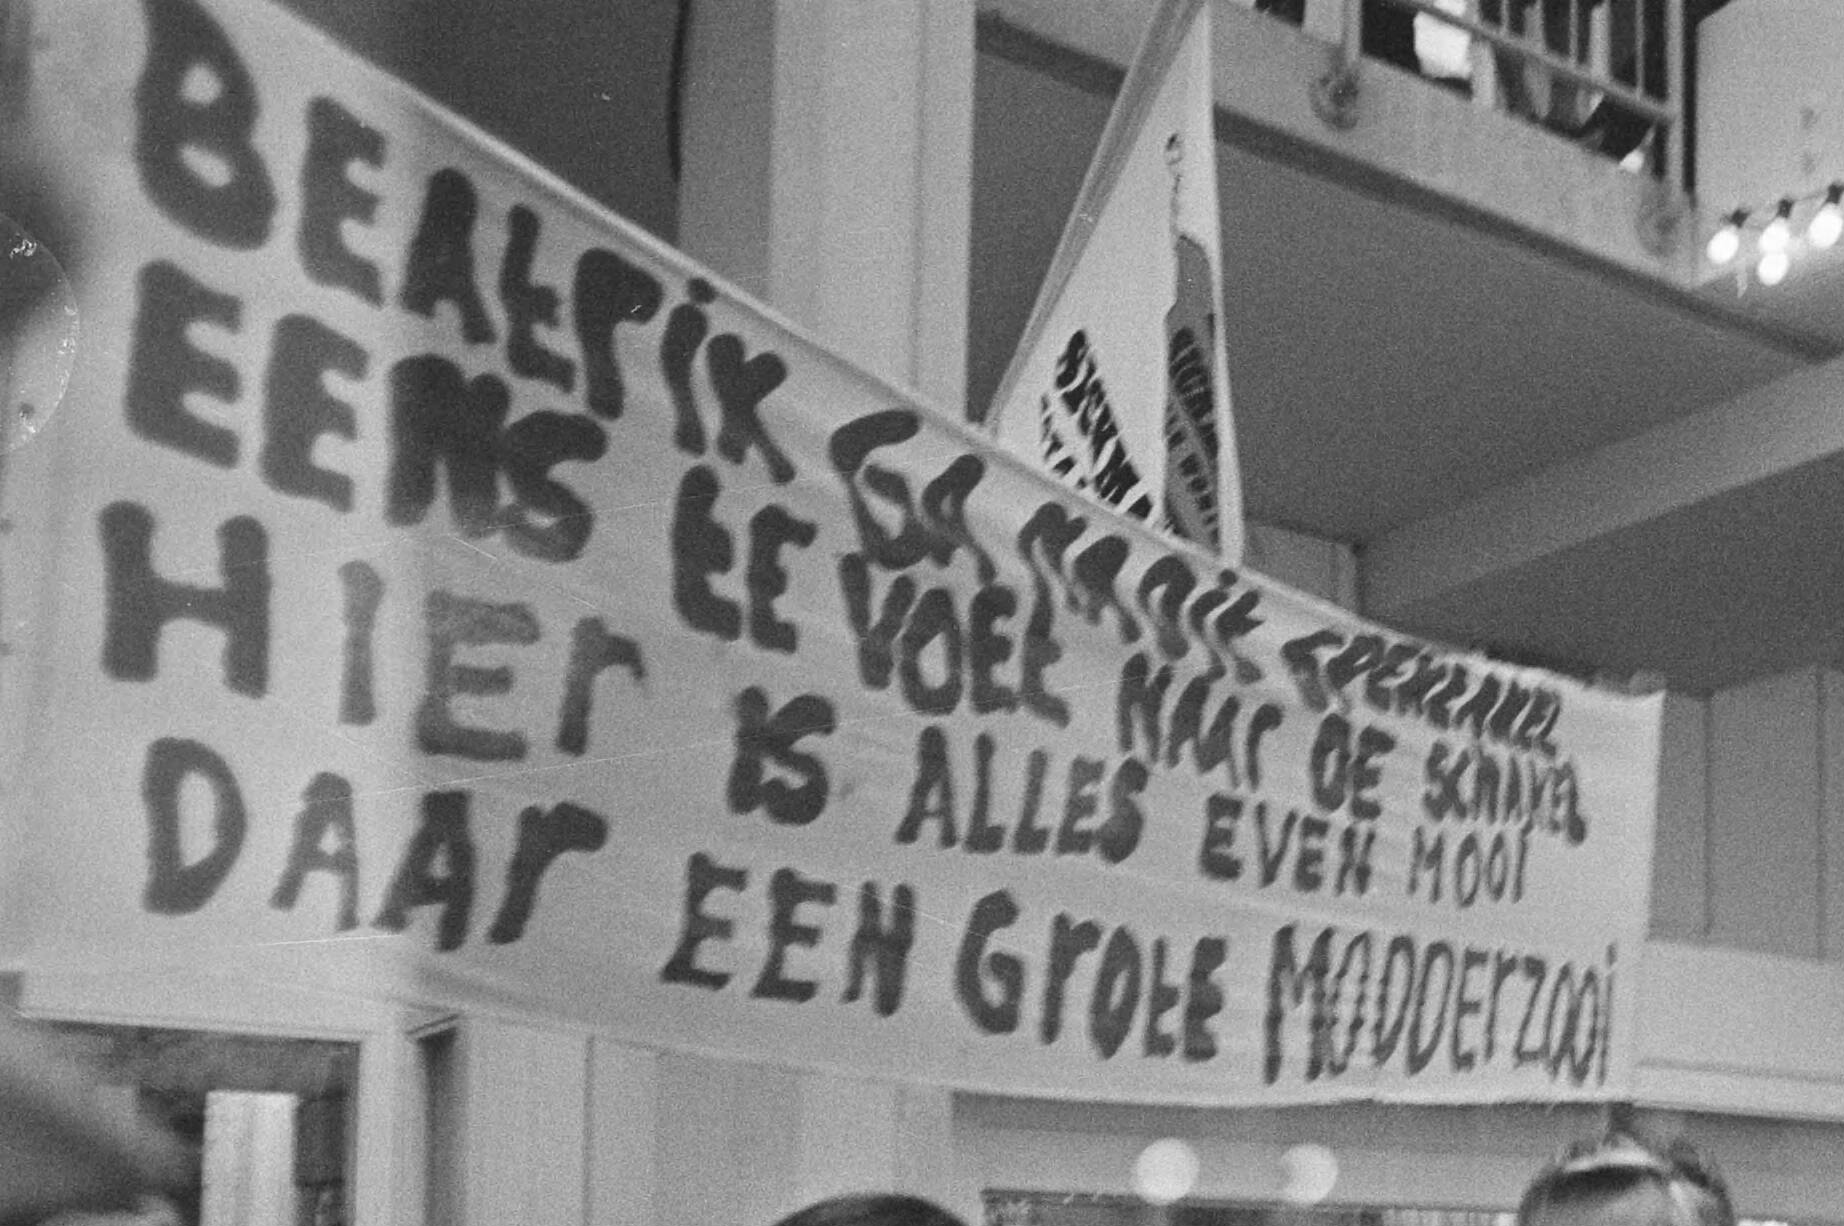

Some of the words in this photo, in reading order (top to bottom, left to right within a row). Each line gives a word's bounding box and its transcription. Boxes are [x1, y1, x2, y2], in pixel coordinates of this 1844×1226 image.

[124, 260, 608, 562] EENS
[1310, 713, 1395, 820] DE
[828, 409, 992, 582] GA
[895, 726, 1149, 863] ALLES
[1202, 792, 1376, 895] EVEN
[660, 852, 916, 1018] EEN
